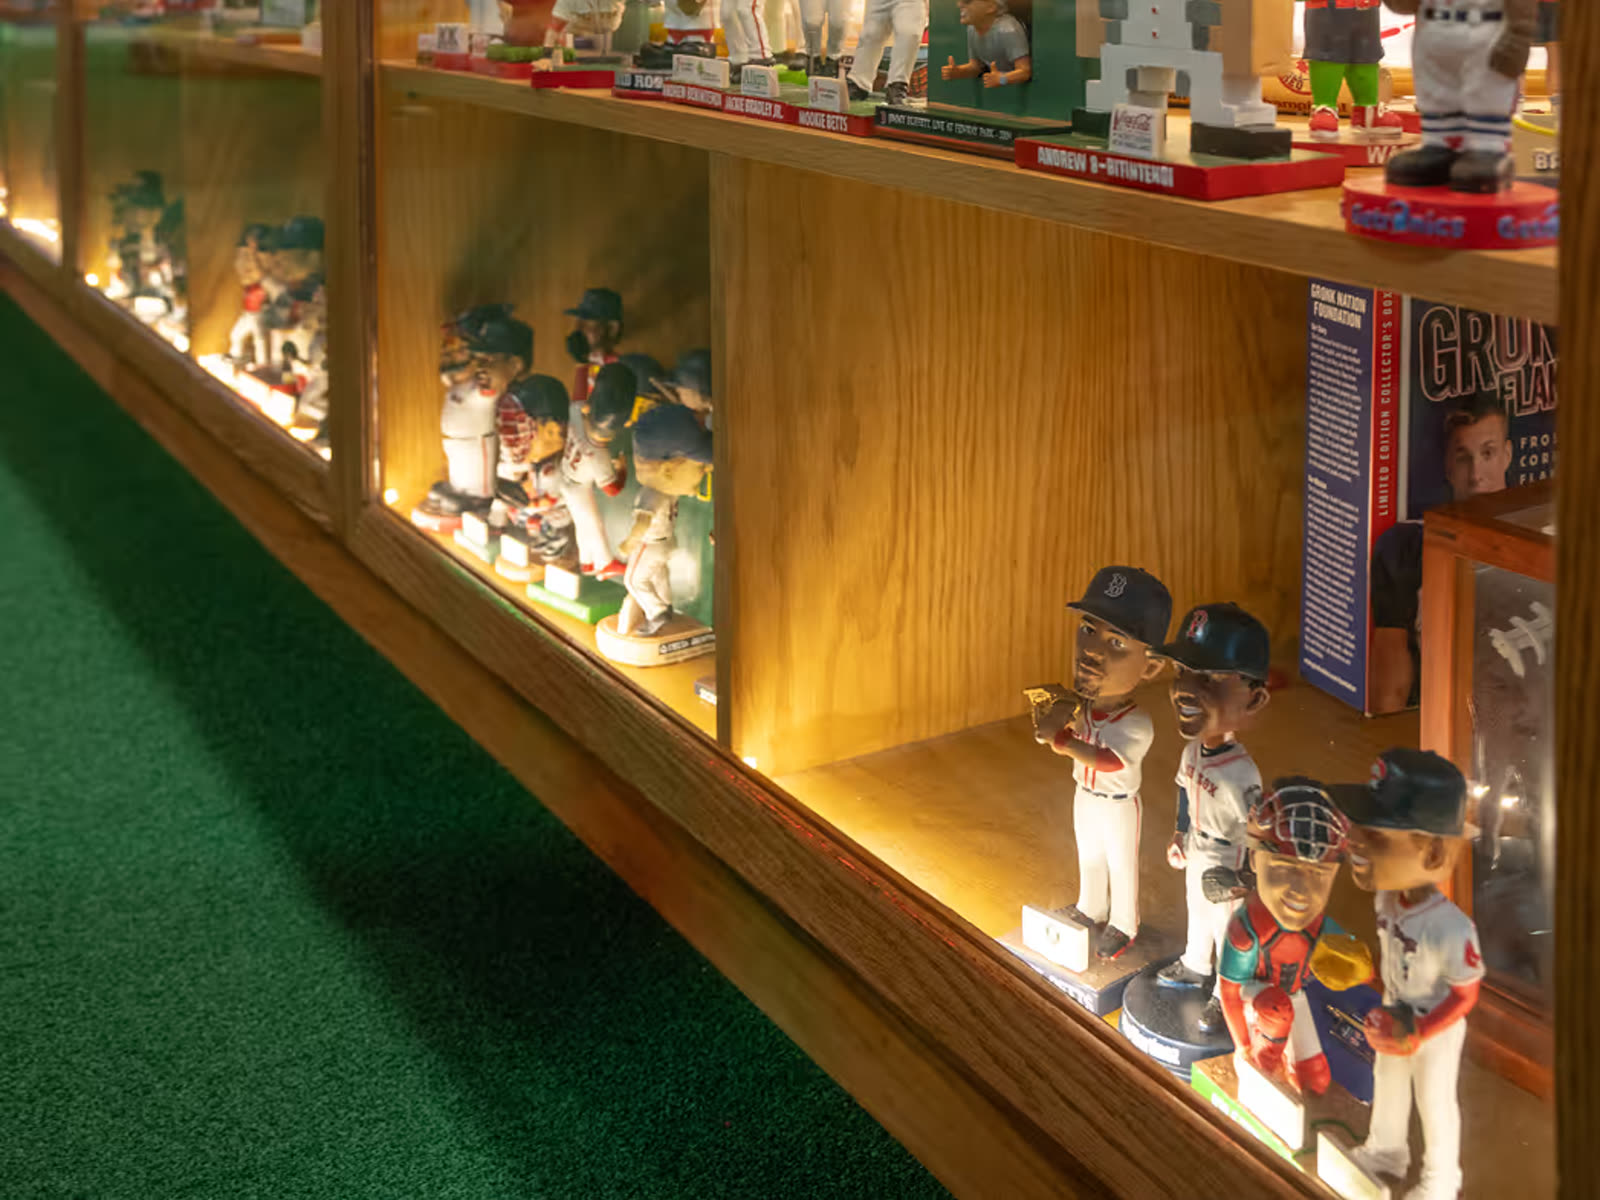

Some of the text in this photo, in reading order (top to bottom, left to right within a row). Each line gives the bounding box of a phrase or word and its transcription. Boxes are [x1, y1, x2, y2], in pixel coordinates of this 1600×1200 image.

[798, 111, 848, 132] MOOKIE BETTS
[1036, 146, 1087, 173] ANDREW
[1313, 300, 1362, 329] FOUNDATION
[1336, 290, 1368, 314] NATION
[1381, 320, 1393, 405] COLLECTOR'S
[1379, 410, 1391, 460] EDITION
[1378, 464, 1390, 516] LIMITED
